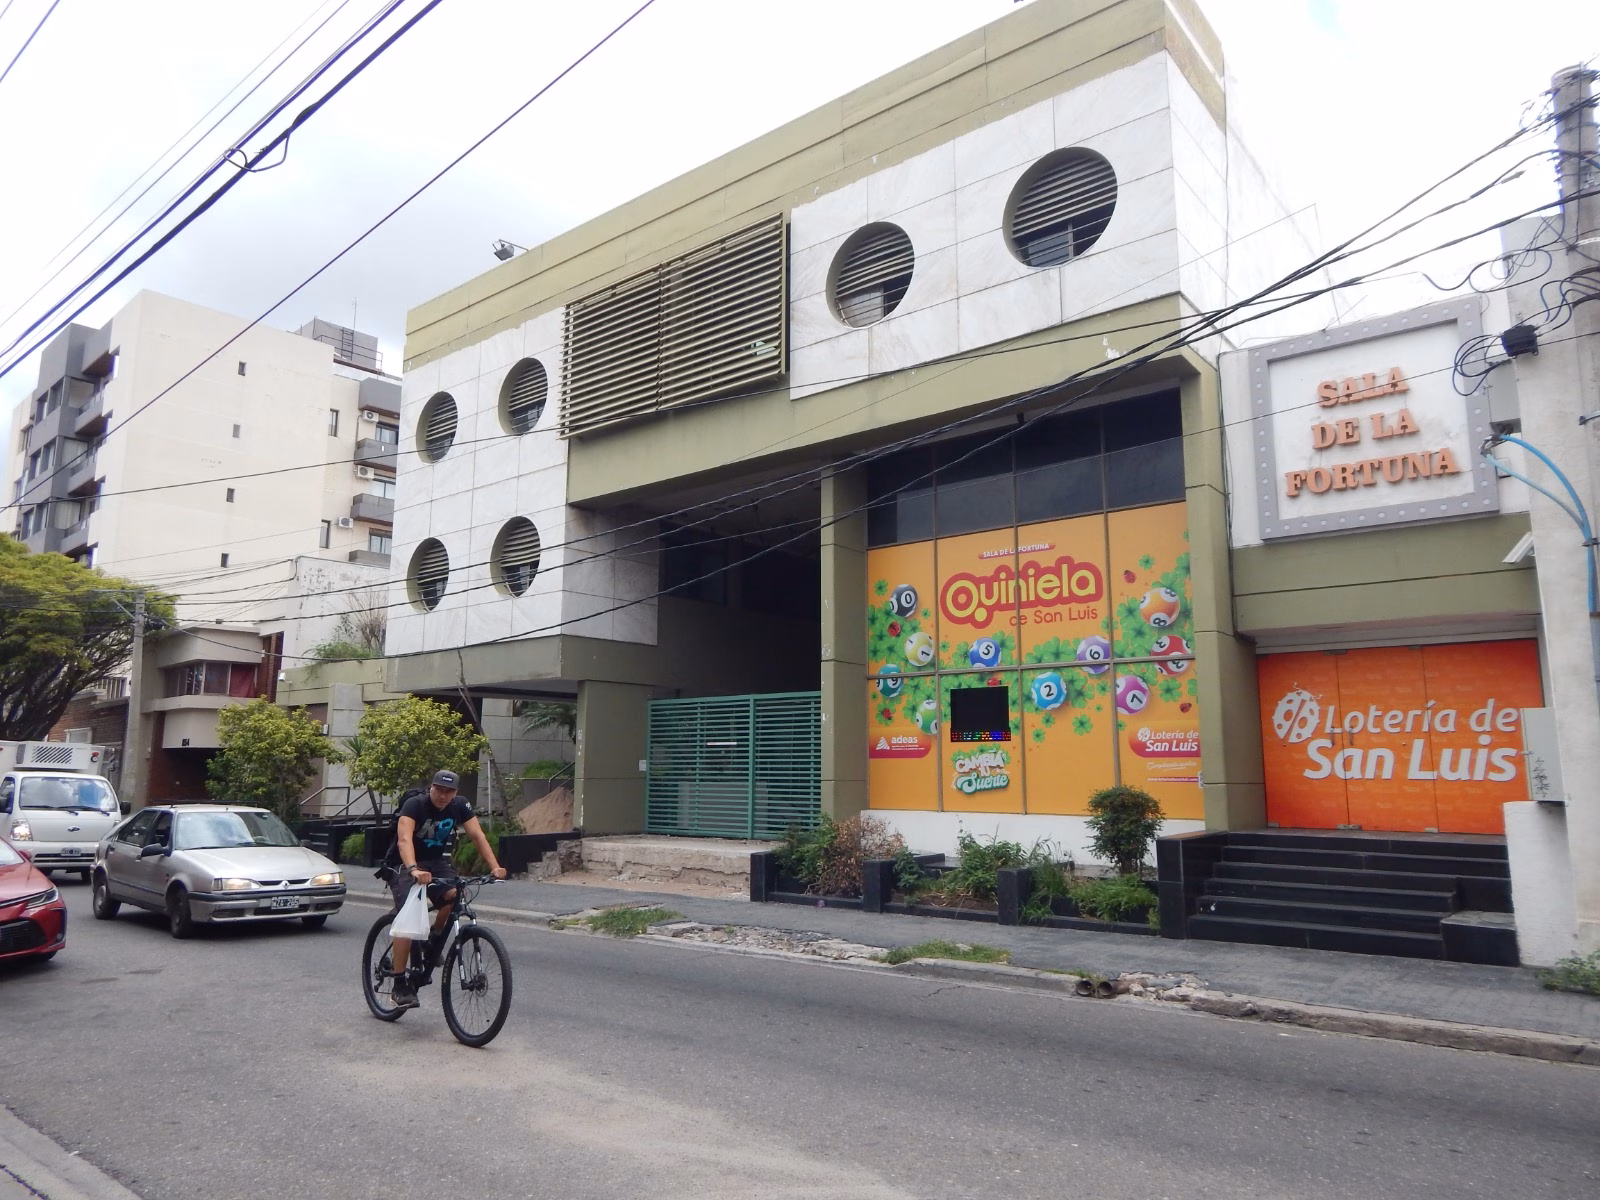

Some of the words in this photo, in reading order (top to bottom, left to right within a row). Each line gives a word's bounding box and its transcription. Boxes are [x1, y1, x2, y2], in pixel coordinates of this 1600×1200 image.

[1317, 367, 1409, 408] SALA
[1311, 417, 1361, 449] DE
[1370, 408, 1420, 440] LA
[1285, 447, 1461, 497] FORTUNA
[983, 550, 999, 558] SALA
[1017, 543, 1050, 553] FORTUNA
[946, 563, 1096, 623] Quiniela
[1033, 609, 1064, 625] San
[1068, 606, 1099, 622] Luis
[982, 644, 993, 656] 5
[1044, 685, 1054, 697] 2
[1324, 699, 1458, 734] Lotería
[1469, 698, 1519, 733] de
[891, 735, 918, 744] adeas
[1187, 730, 1199, 739] de
[1145, 740, 1169, 752] San
[1171, 739, 1198, 752] Luis
[1303, 738, 1395, 780] San
[1407, 734, 1519, 782] Luis
[956, 772, 1009, 793] Suerte
